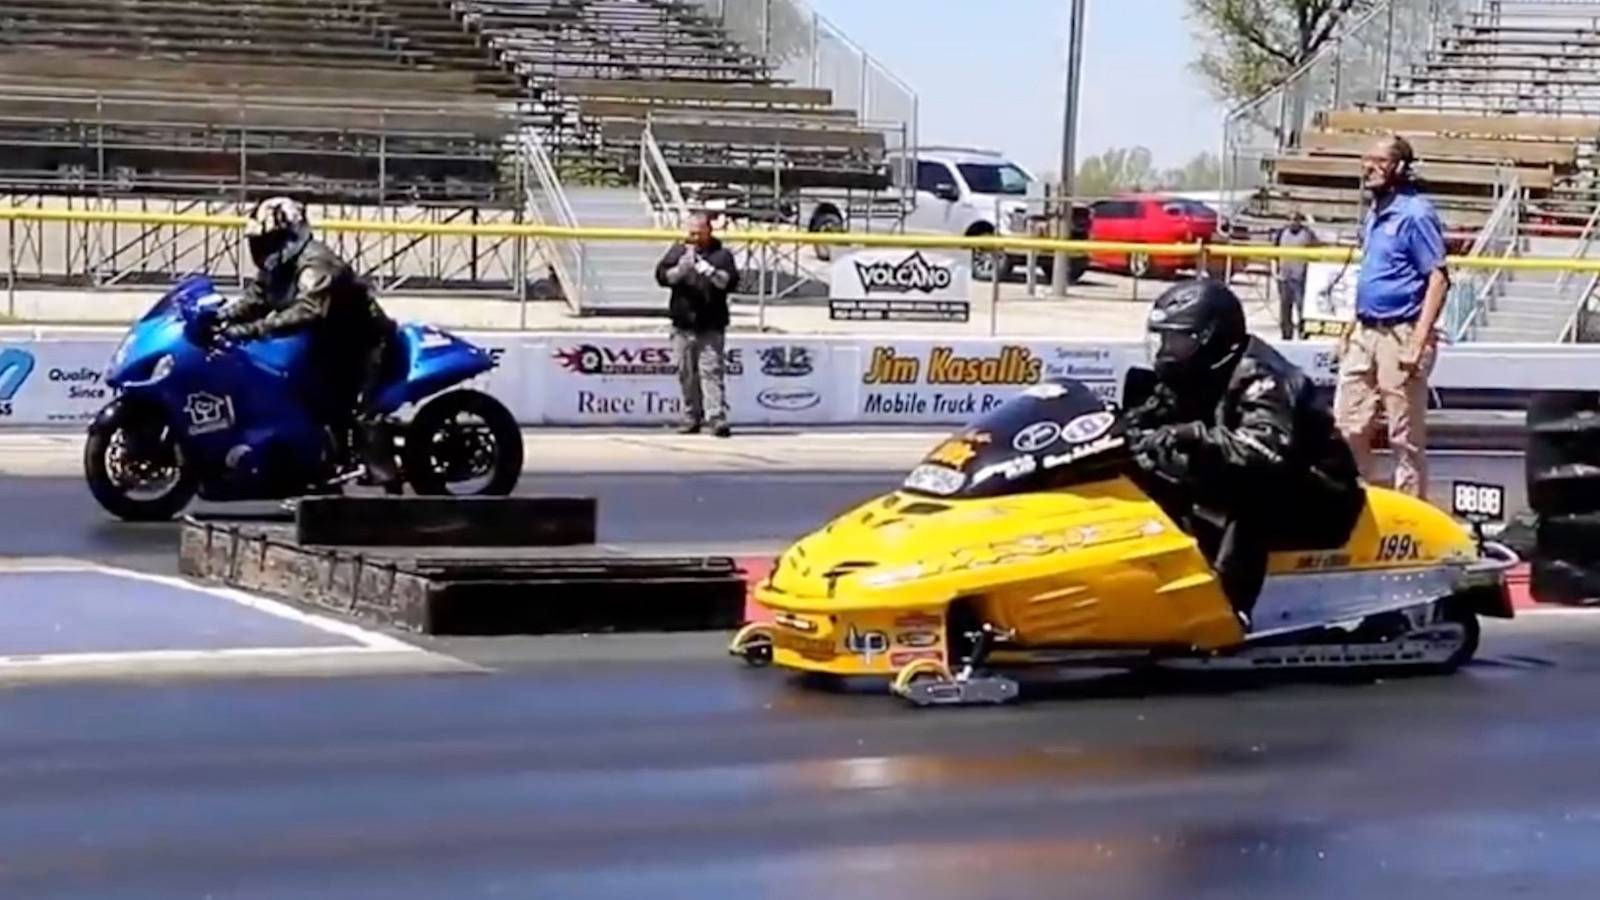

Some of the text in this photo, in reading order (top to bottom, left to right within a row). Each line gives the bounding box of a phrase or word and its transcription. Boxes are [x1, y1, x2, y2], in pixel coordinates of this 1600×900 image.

[855, 251, 950, 293] VOLCANO
[49, 368, 102, 384] Quality
[862, 346, 1043, 385] Jim Kasallis
[69, 386, 106, 398] Since
[578, 391, 635, 414] Race
[864, 395, 927, 414] Mobile
[933, 394, 978, 413] Truck
